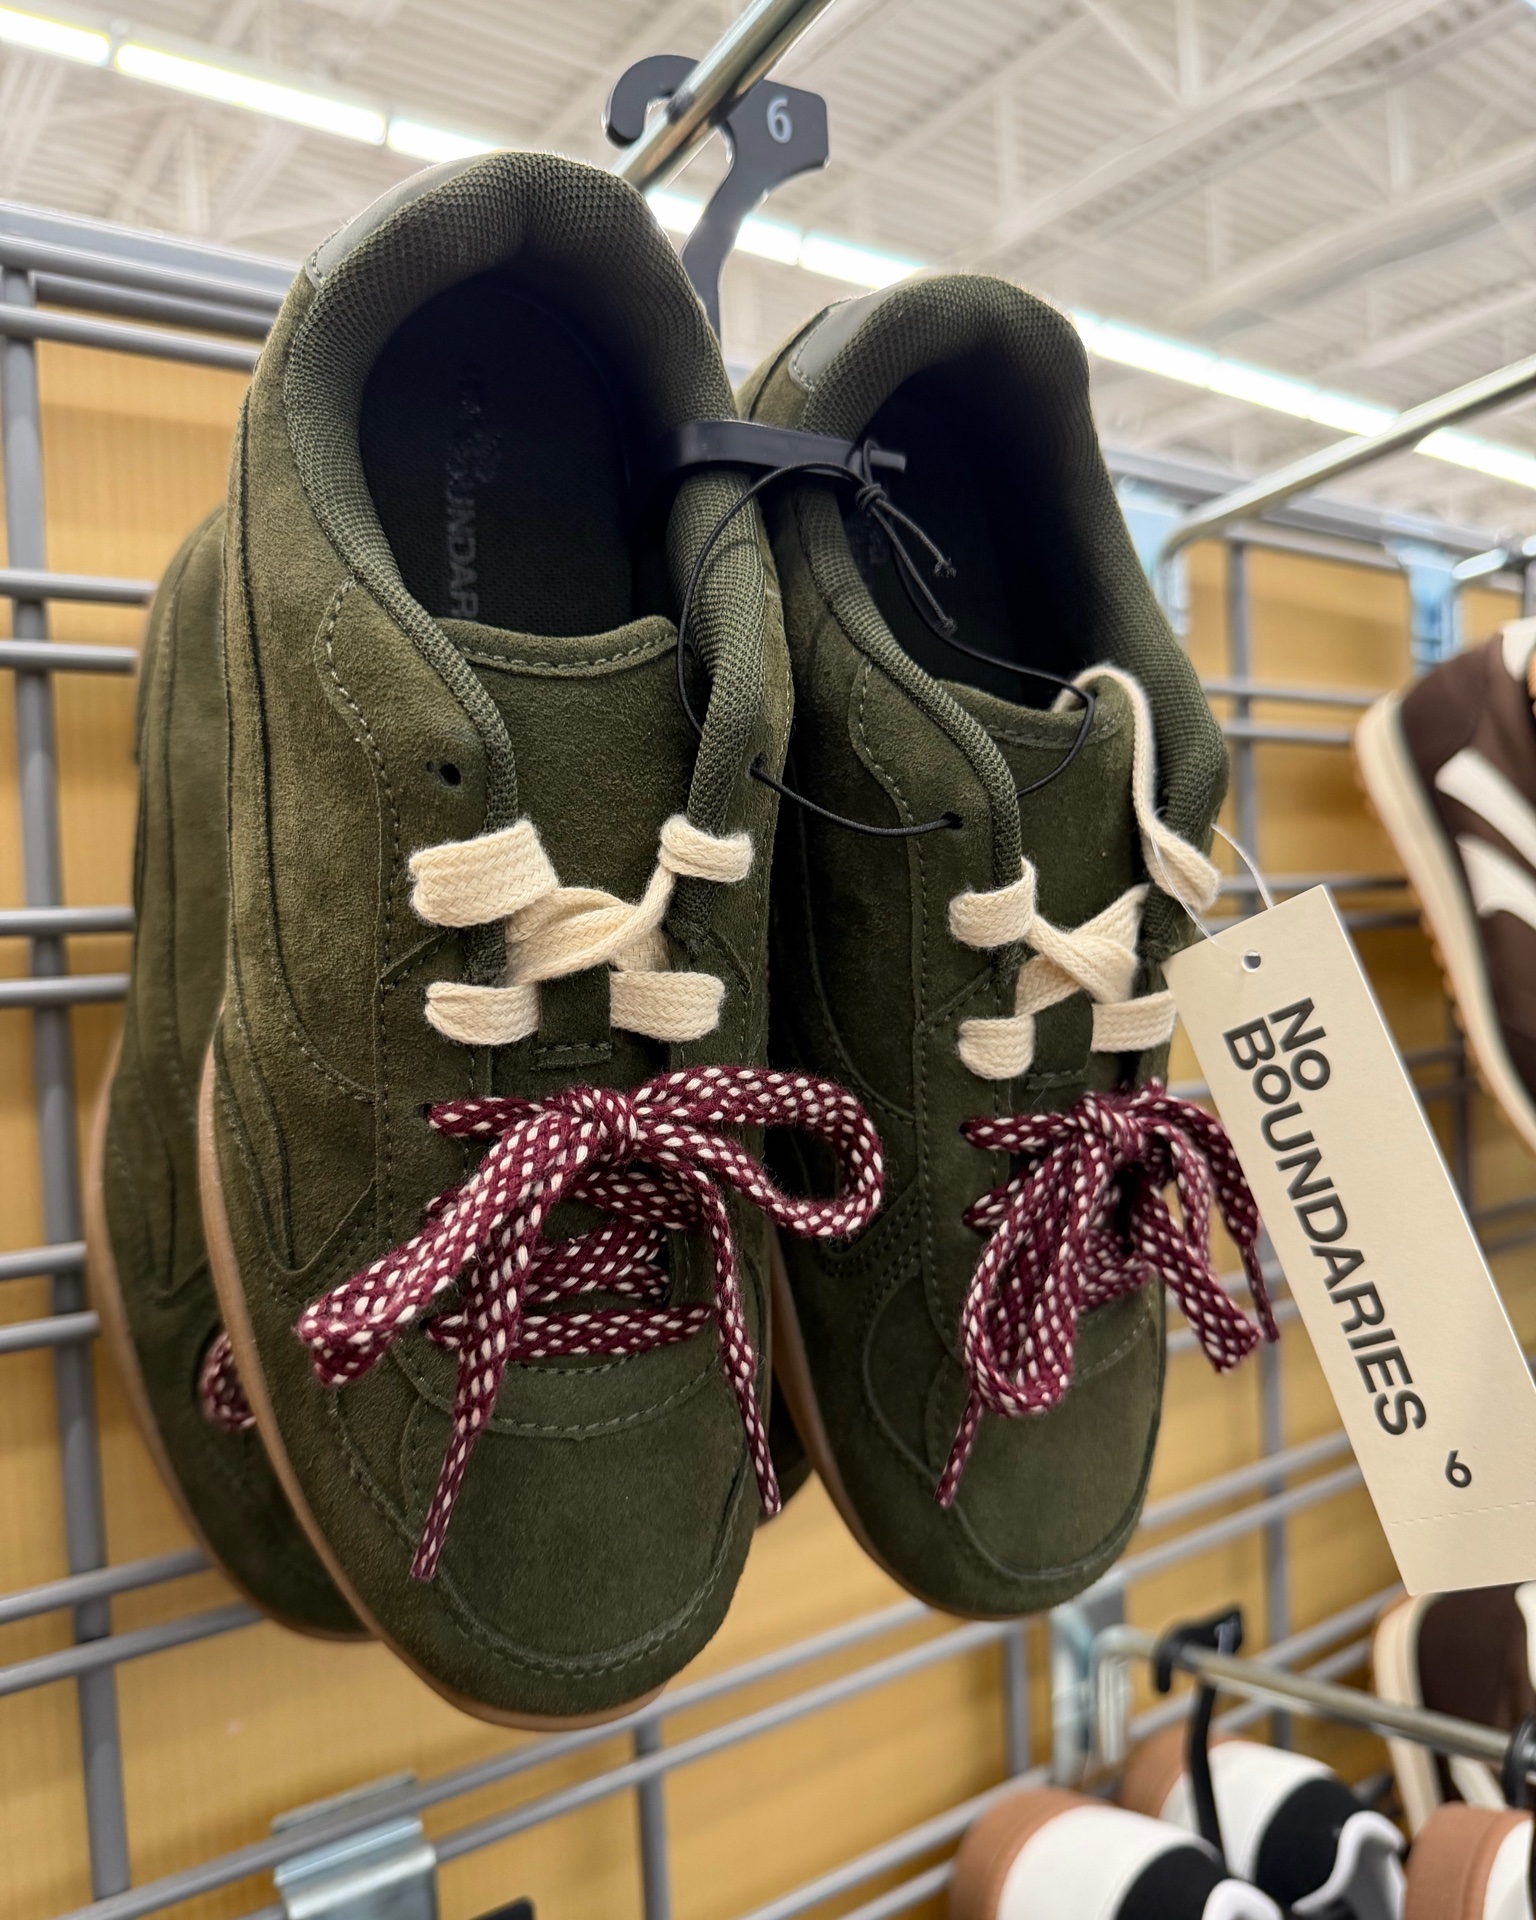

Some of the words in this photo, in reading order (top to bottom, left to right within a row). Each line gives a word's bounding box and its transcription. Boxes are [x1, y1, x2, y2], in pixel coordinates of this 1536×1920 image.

[766, 95, 792, 144] 6
[1267, 997, 1331, 1091] NO
[1222, 1016, 1427, 1436] BOUNDARIES
[1445, 1450, 1472, 1488] 6
